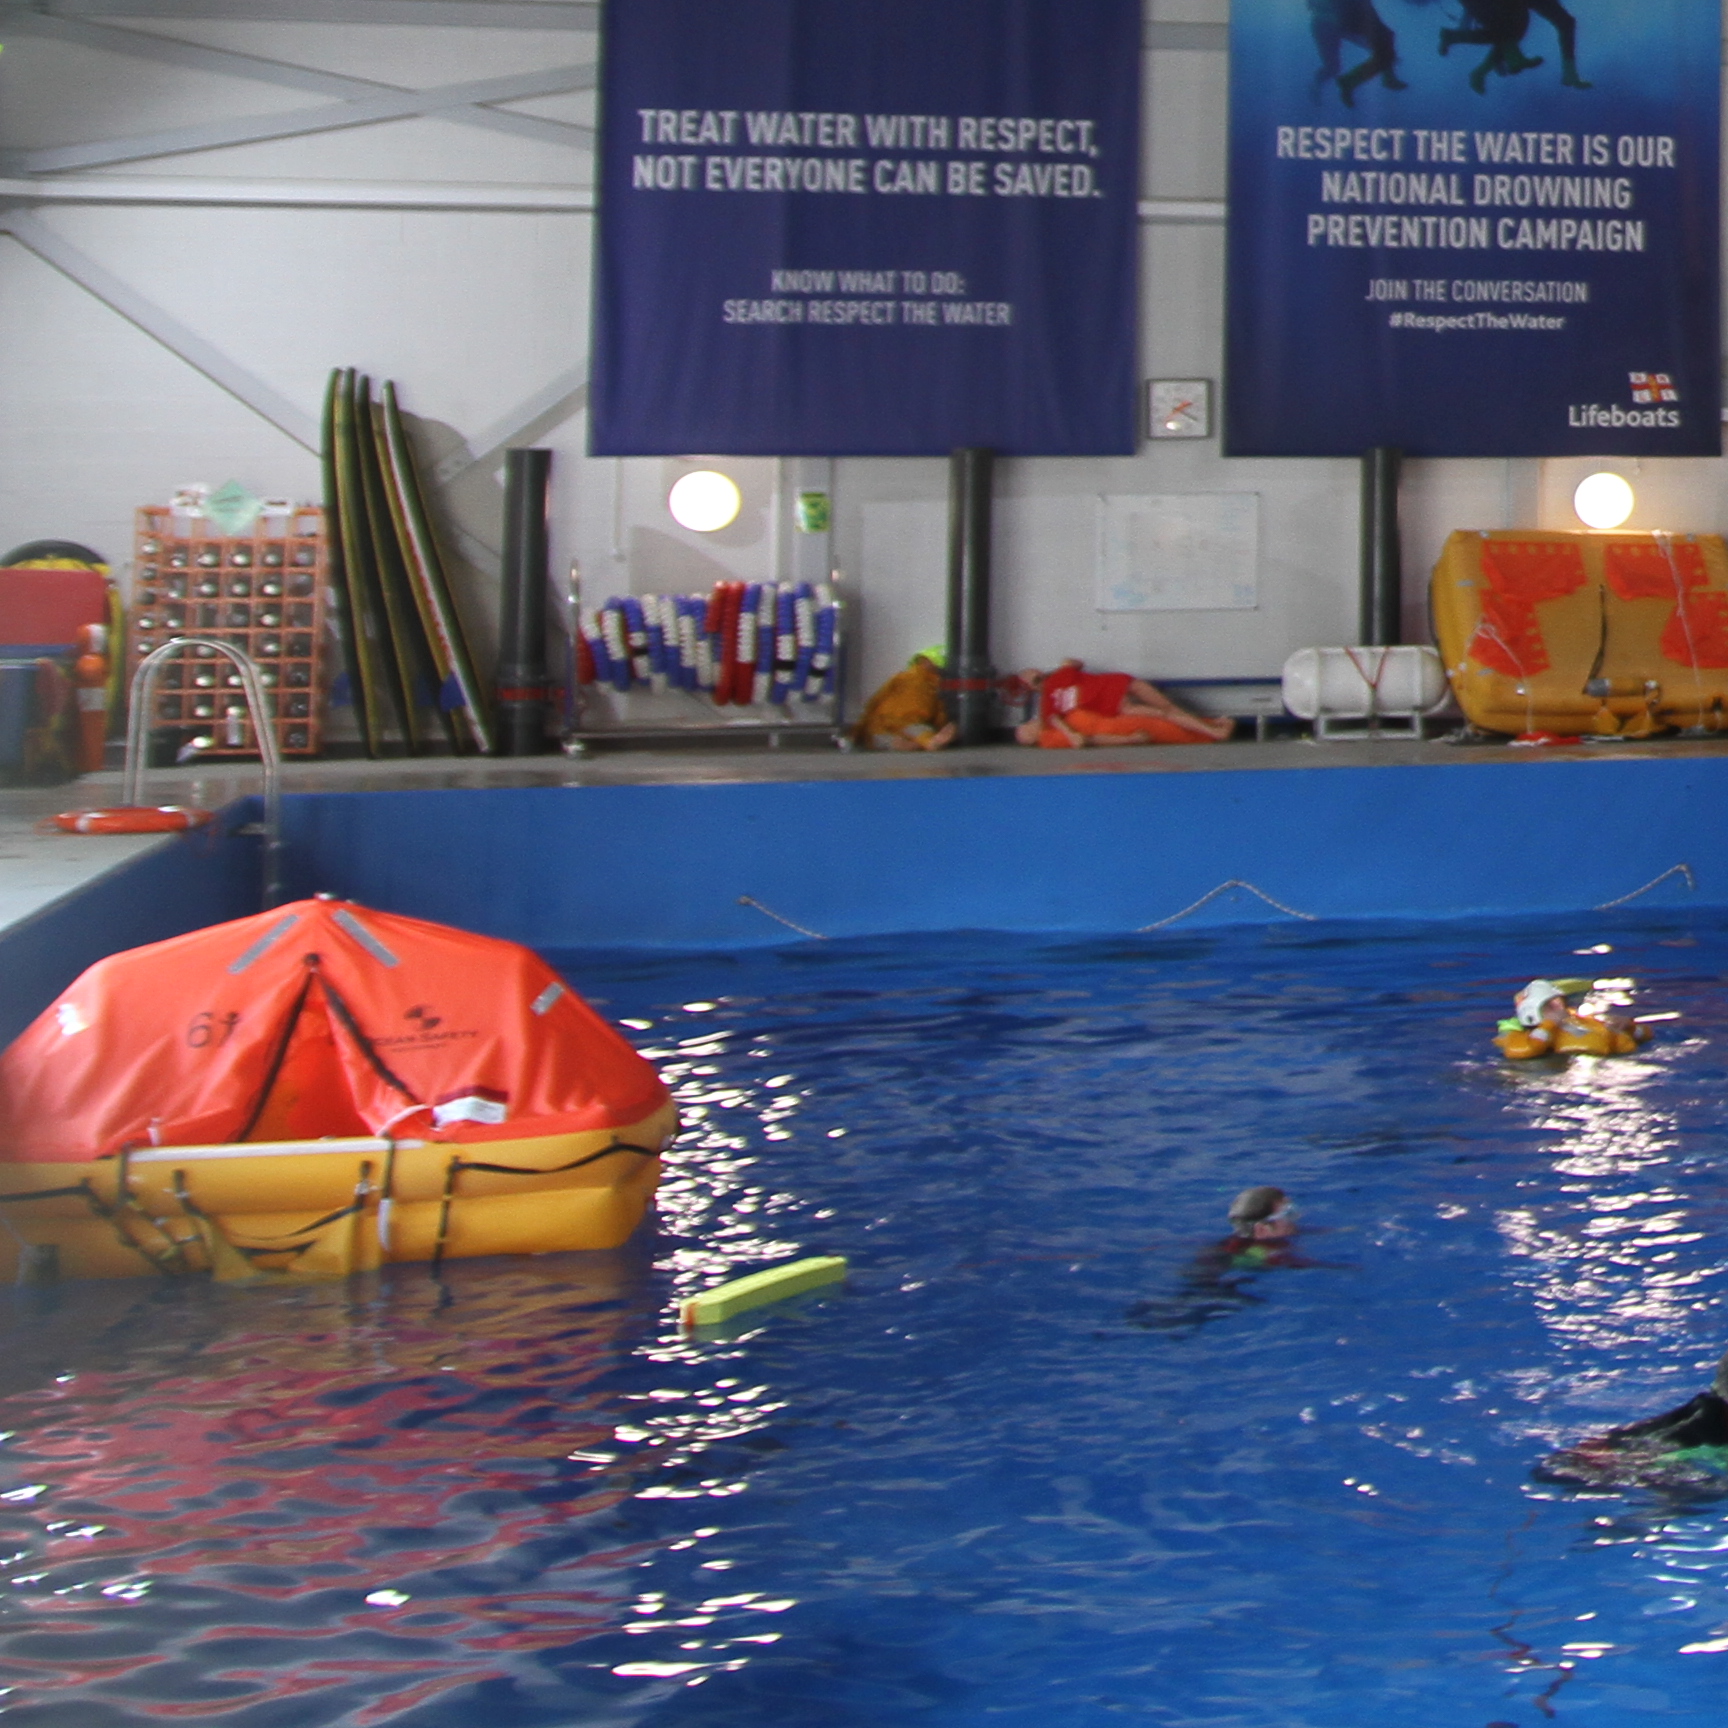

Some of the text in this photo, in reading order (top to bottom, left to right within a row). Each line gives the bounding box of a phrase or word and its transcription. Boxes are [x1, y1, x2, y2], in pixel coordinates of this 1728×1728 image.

[637, 108, 1099, 158] TREAT WATER WITH RESPECT,
[1276, 126, 1676, 168] RESPECT THE WATER IS OUR
[632, 154, 1103, 198] NOT EVERYONE CAN BE SAVED.
[1321, 171, 1632, 210] NATIONAL DROWNING
[1307, 213, 1645, 252] PREVENTION CAMPAIGN
[770, 269, 967, 296] KNOW WHAT TO DO:
[1364, 279, 1589, 303] JOIN THE CONVERSATION
[722, 298, 1012, 326] SEARCH RESPECT THE WATER
[1388, 311, 1566, 333] #RespectTheWater
[1568, 403, 1680, 427] Lifeboats
